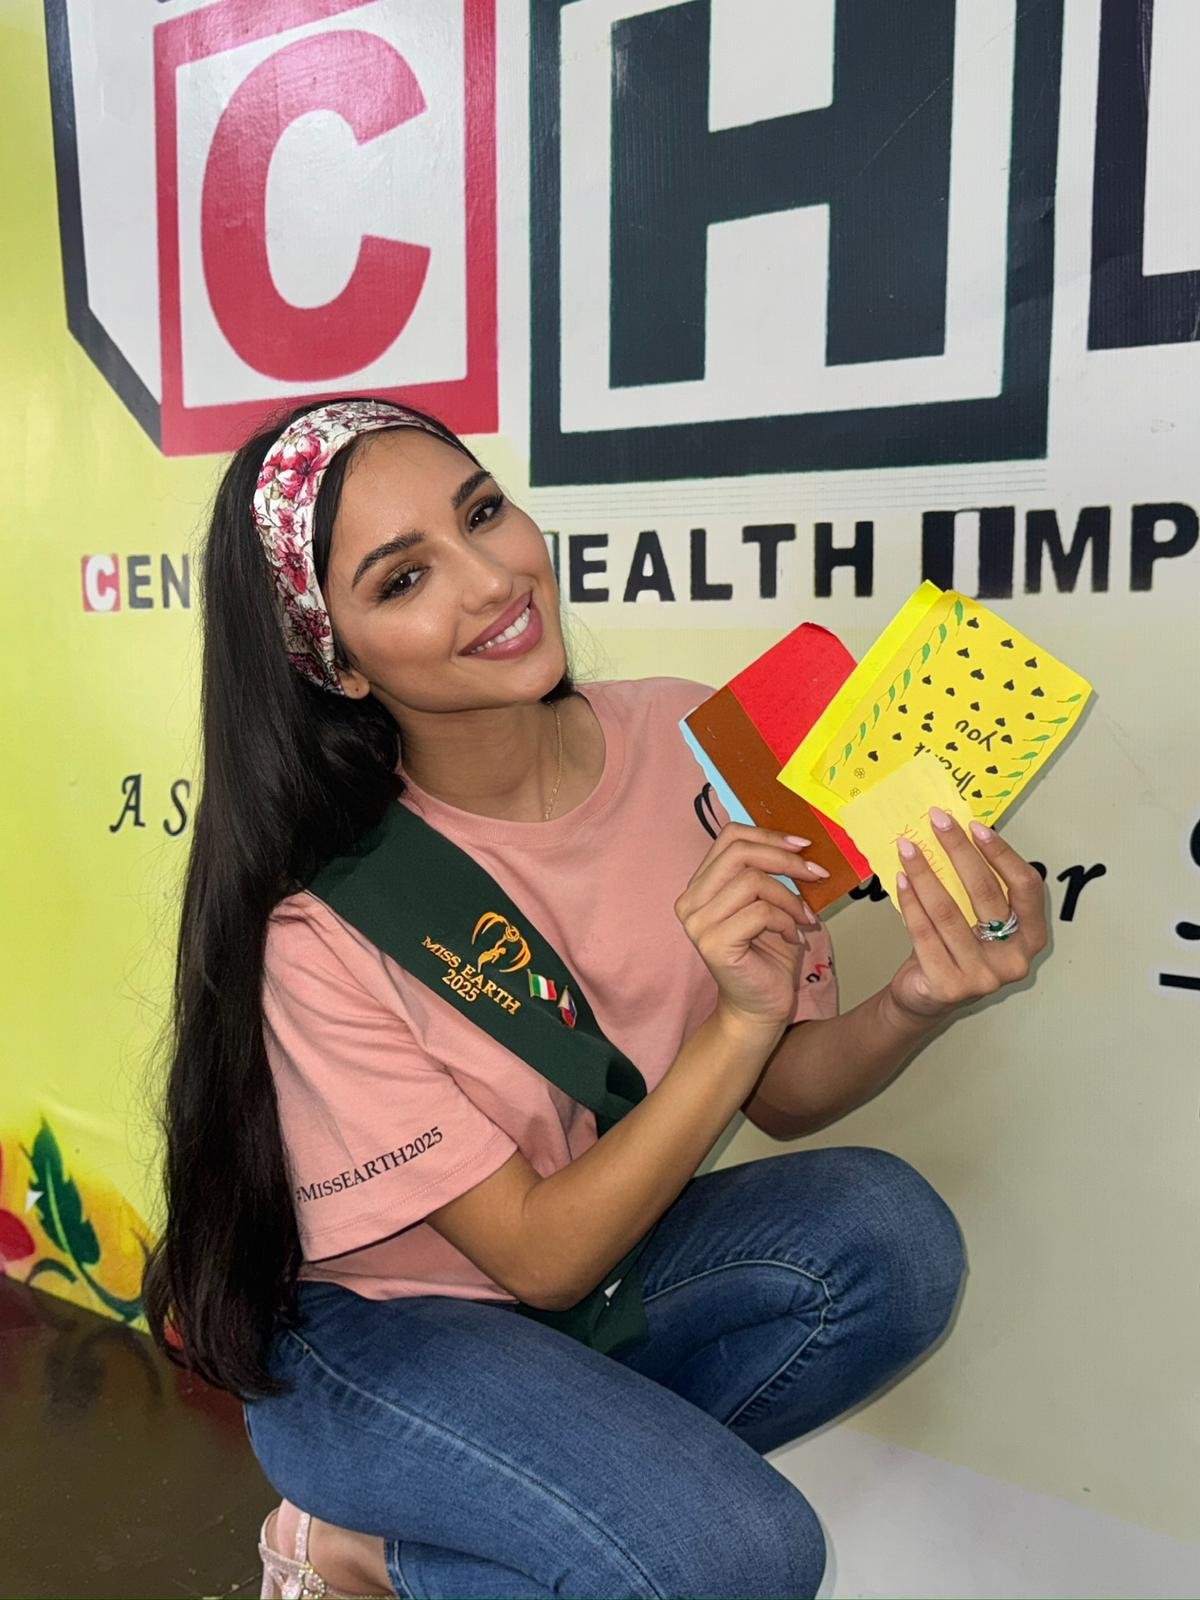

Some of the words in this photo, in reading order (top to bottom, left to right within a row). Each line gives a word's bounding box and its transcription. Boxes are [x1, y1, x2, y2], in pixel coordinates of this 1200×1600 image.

[82, 553, 191, 611] CEN
[543, 520, 874, 602] EALTH
[955, 719, 998, 752] you
[108, 773, 146, 833] A
[163, 779, 191, 837] S
[421, 935, 462, 968] MISS
[460, 964, 522, 1015] EARTH
[441, 968, 480, 1002] 2025
